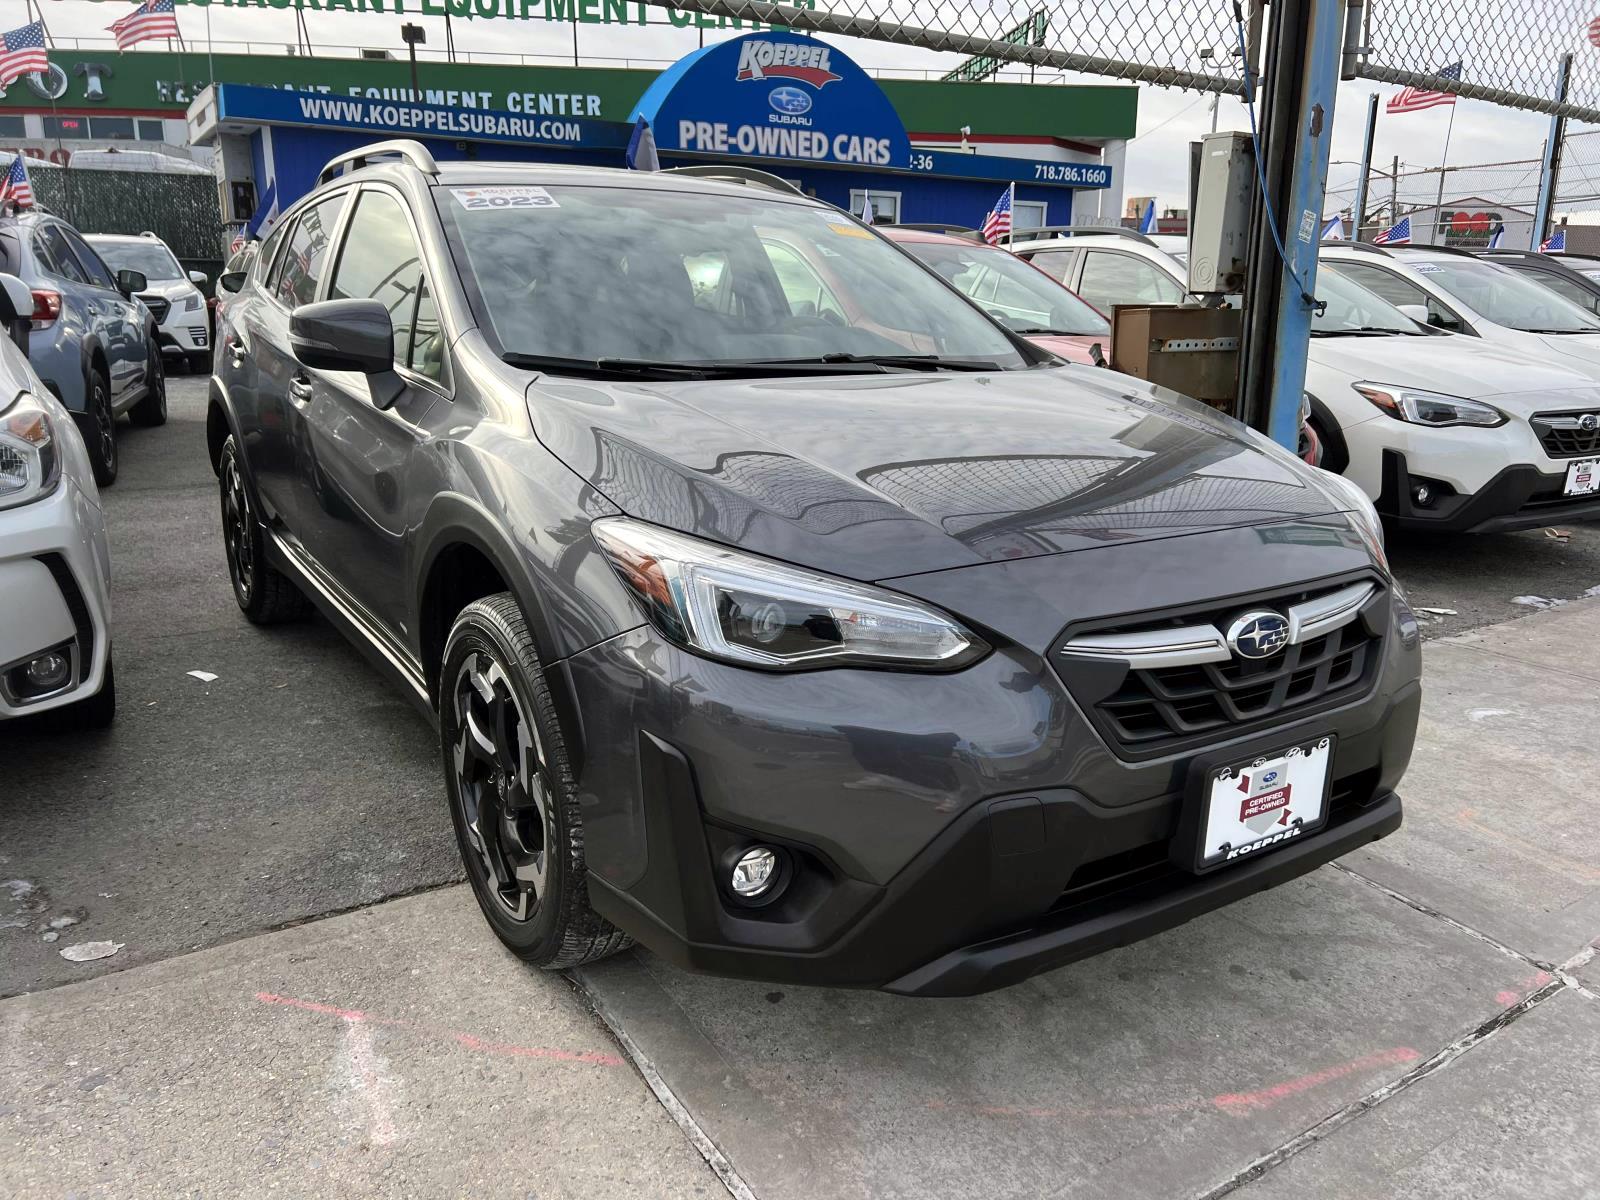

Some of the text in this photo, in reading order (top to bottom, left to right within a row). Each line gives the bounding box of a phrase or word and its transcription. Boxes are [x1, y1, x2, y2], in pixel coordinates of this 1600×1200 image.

[738, 40, 831, 78] KOEPPEL
[0, 61, 113, 101] OT
[506, 91, 602, 116] CENTER
[300, 97, 581, 141] WWW.KOEPPELSUBARU.COM
[769, 114, 812, 126] SUBARU
[679, 119, 891, 165] PRE-OWNED CARS
[909, 154, 1106, 184] -36 718.786.1660
[466, 196, 553, 208] 2023
[1244, 797, 1286, 816] PRE-OWNED
[1249, 791, 1284, 807] CERTIFIED
[1226, 827, 1302, 860] KOEPPEL
